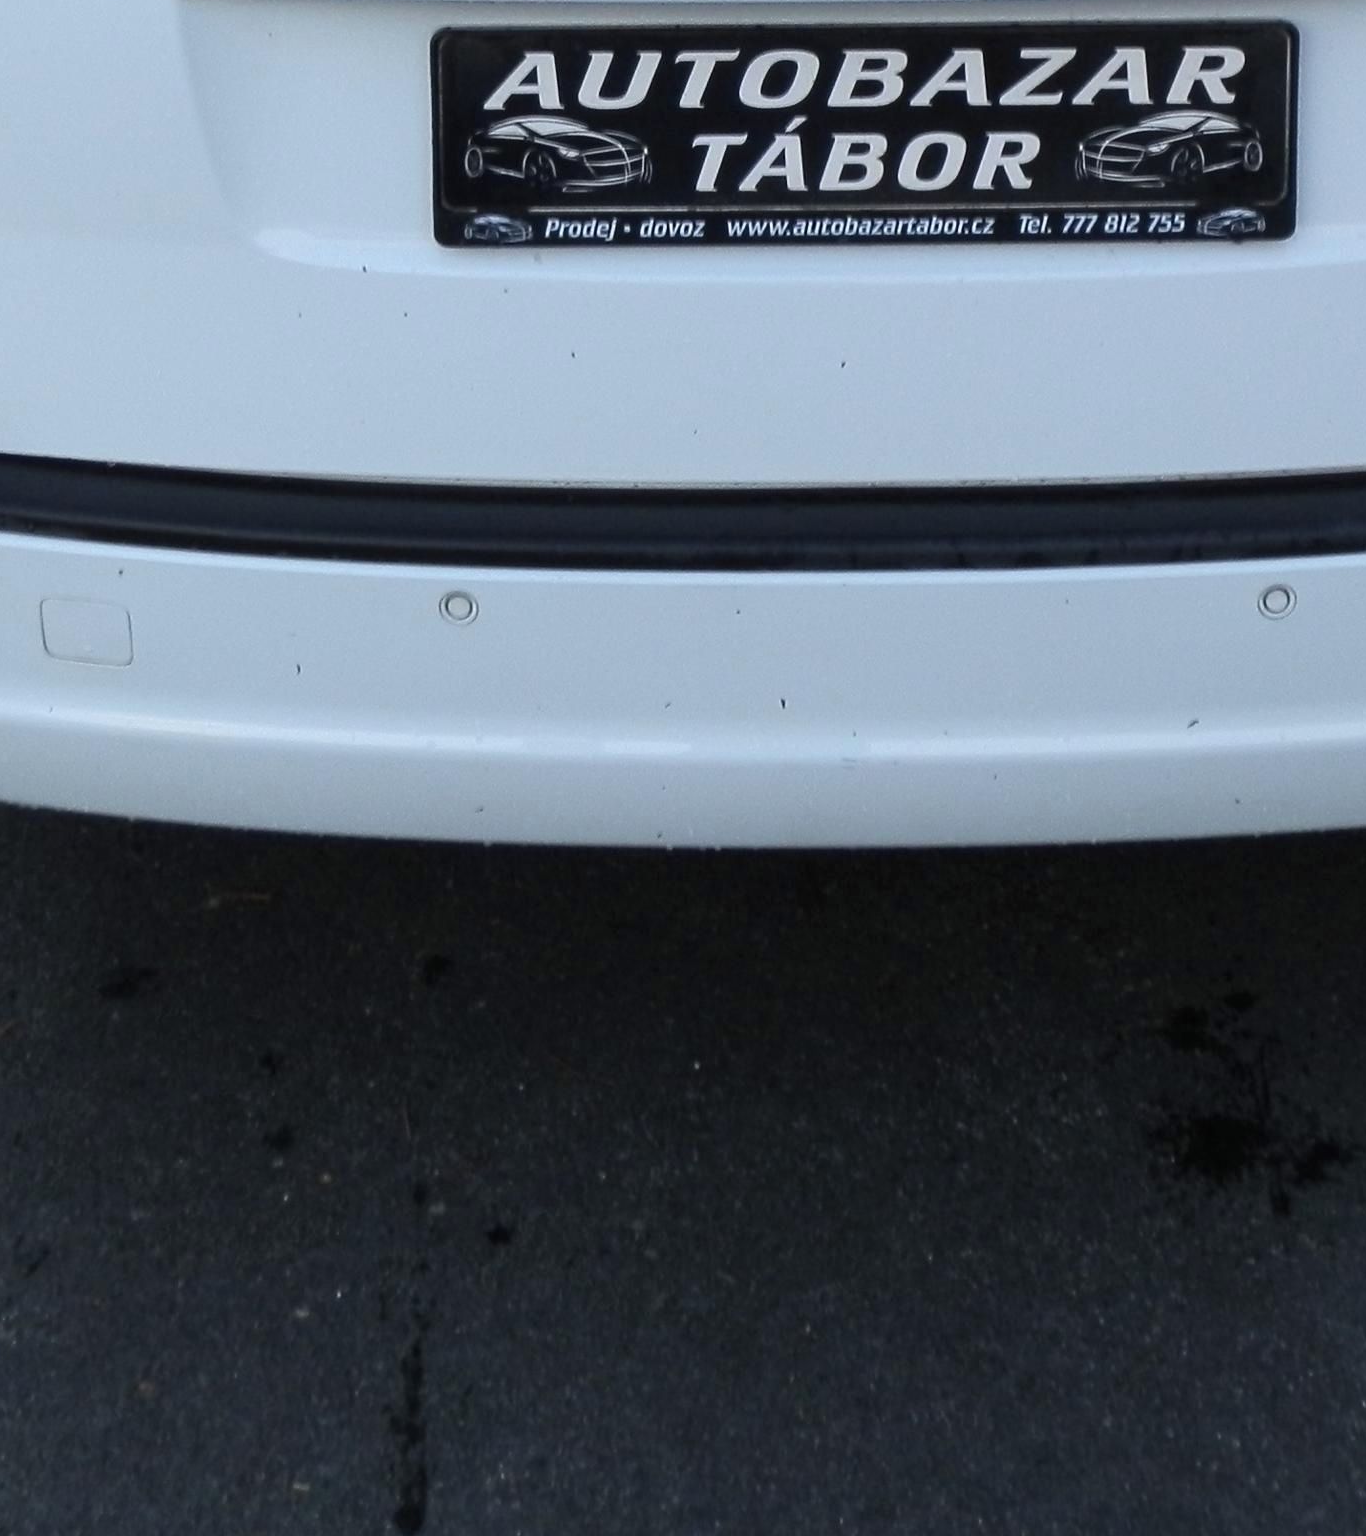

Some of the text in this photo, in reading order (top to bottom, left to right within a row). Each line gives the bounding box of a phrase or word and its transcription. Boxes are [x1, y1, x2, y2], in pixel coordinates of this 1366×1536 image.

[482, 47, 1246, 111] AUTOBAZAR
[691, 116, 1041, 193] TÁBOR
[544, 213, 1186, 242] Prodej dovoz www.autobazartabor.cz Tel. 777 812 755
